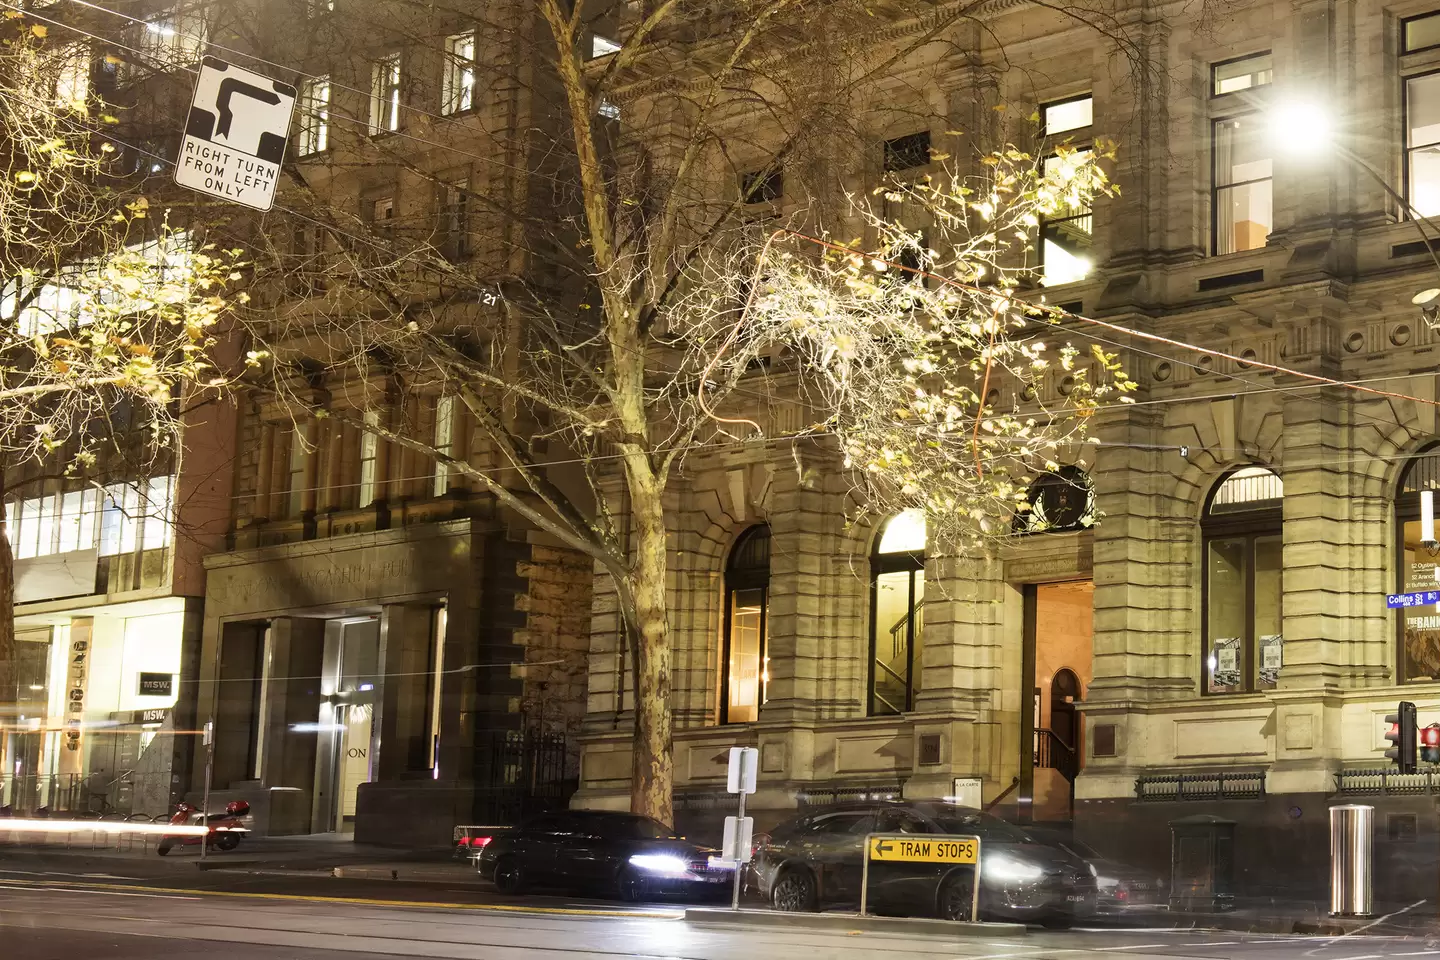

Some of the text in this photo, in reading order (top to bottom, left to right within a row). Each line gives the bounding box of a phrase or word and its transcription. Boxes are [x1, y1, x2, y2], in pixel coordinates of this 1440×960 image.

[186, 142, 275, 180] RIGHT TURN
[185, 157, 270, 192] FROM LEFT
[204, 177, 244, 198] ONLY
[482, 293, 497, 307] 21
[1388, 593, 1423, 604] Collins St
[143, 681, 170, 689] MSW.
[143, 710, 166, 721] MSW.
[900, 842, 973, 858] TRAM STOPS
